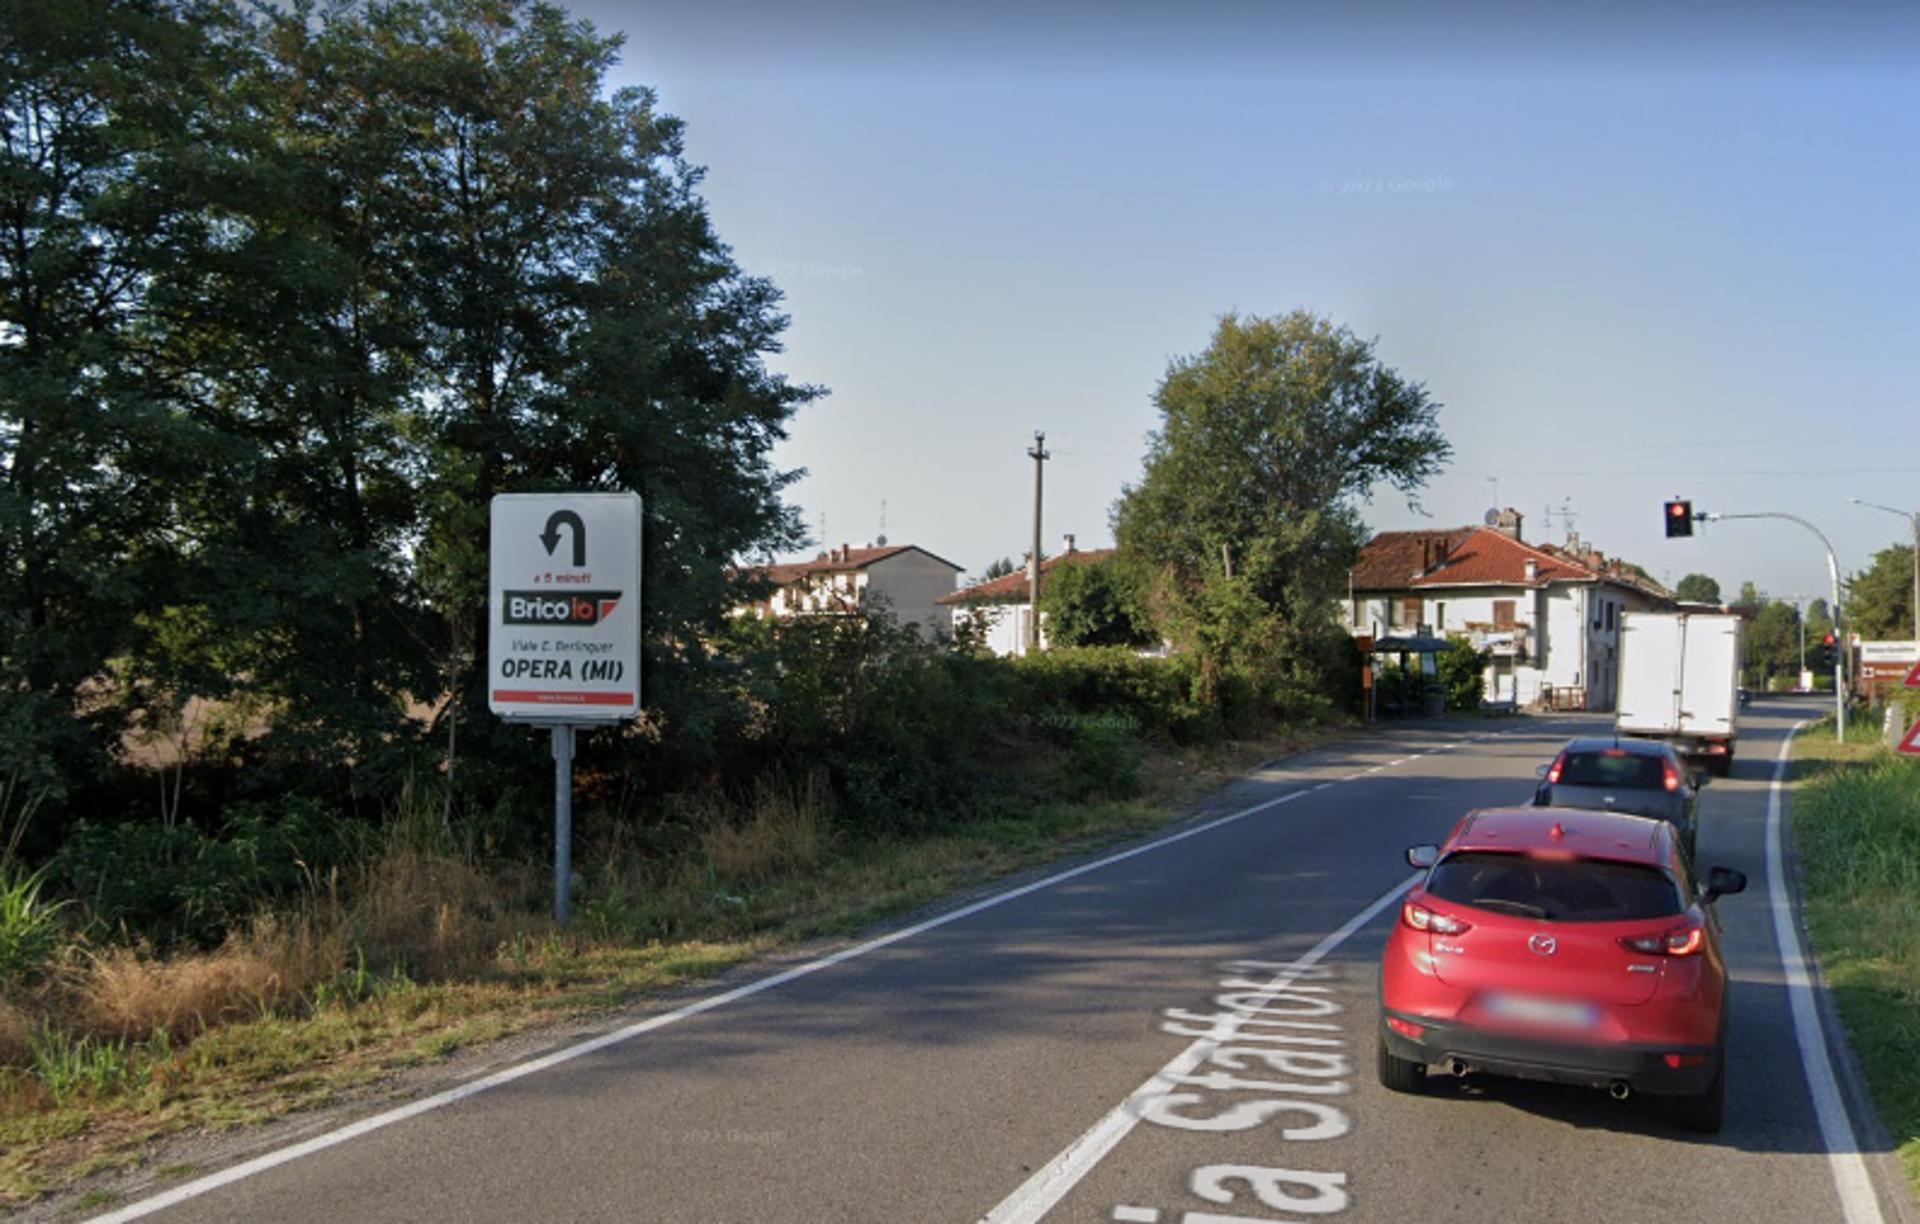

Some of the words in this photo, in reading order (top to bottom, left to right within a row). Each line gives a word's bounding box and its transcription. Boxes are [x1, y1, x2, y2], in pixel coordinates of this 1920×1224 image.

[556, 573, 592, 584] minuti
[501, 658, 573, 680] OPERA
[580, 659, 624, 682] (MI)
